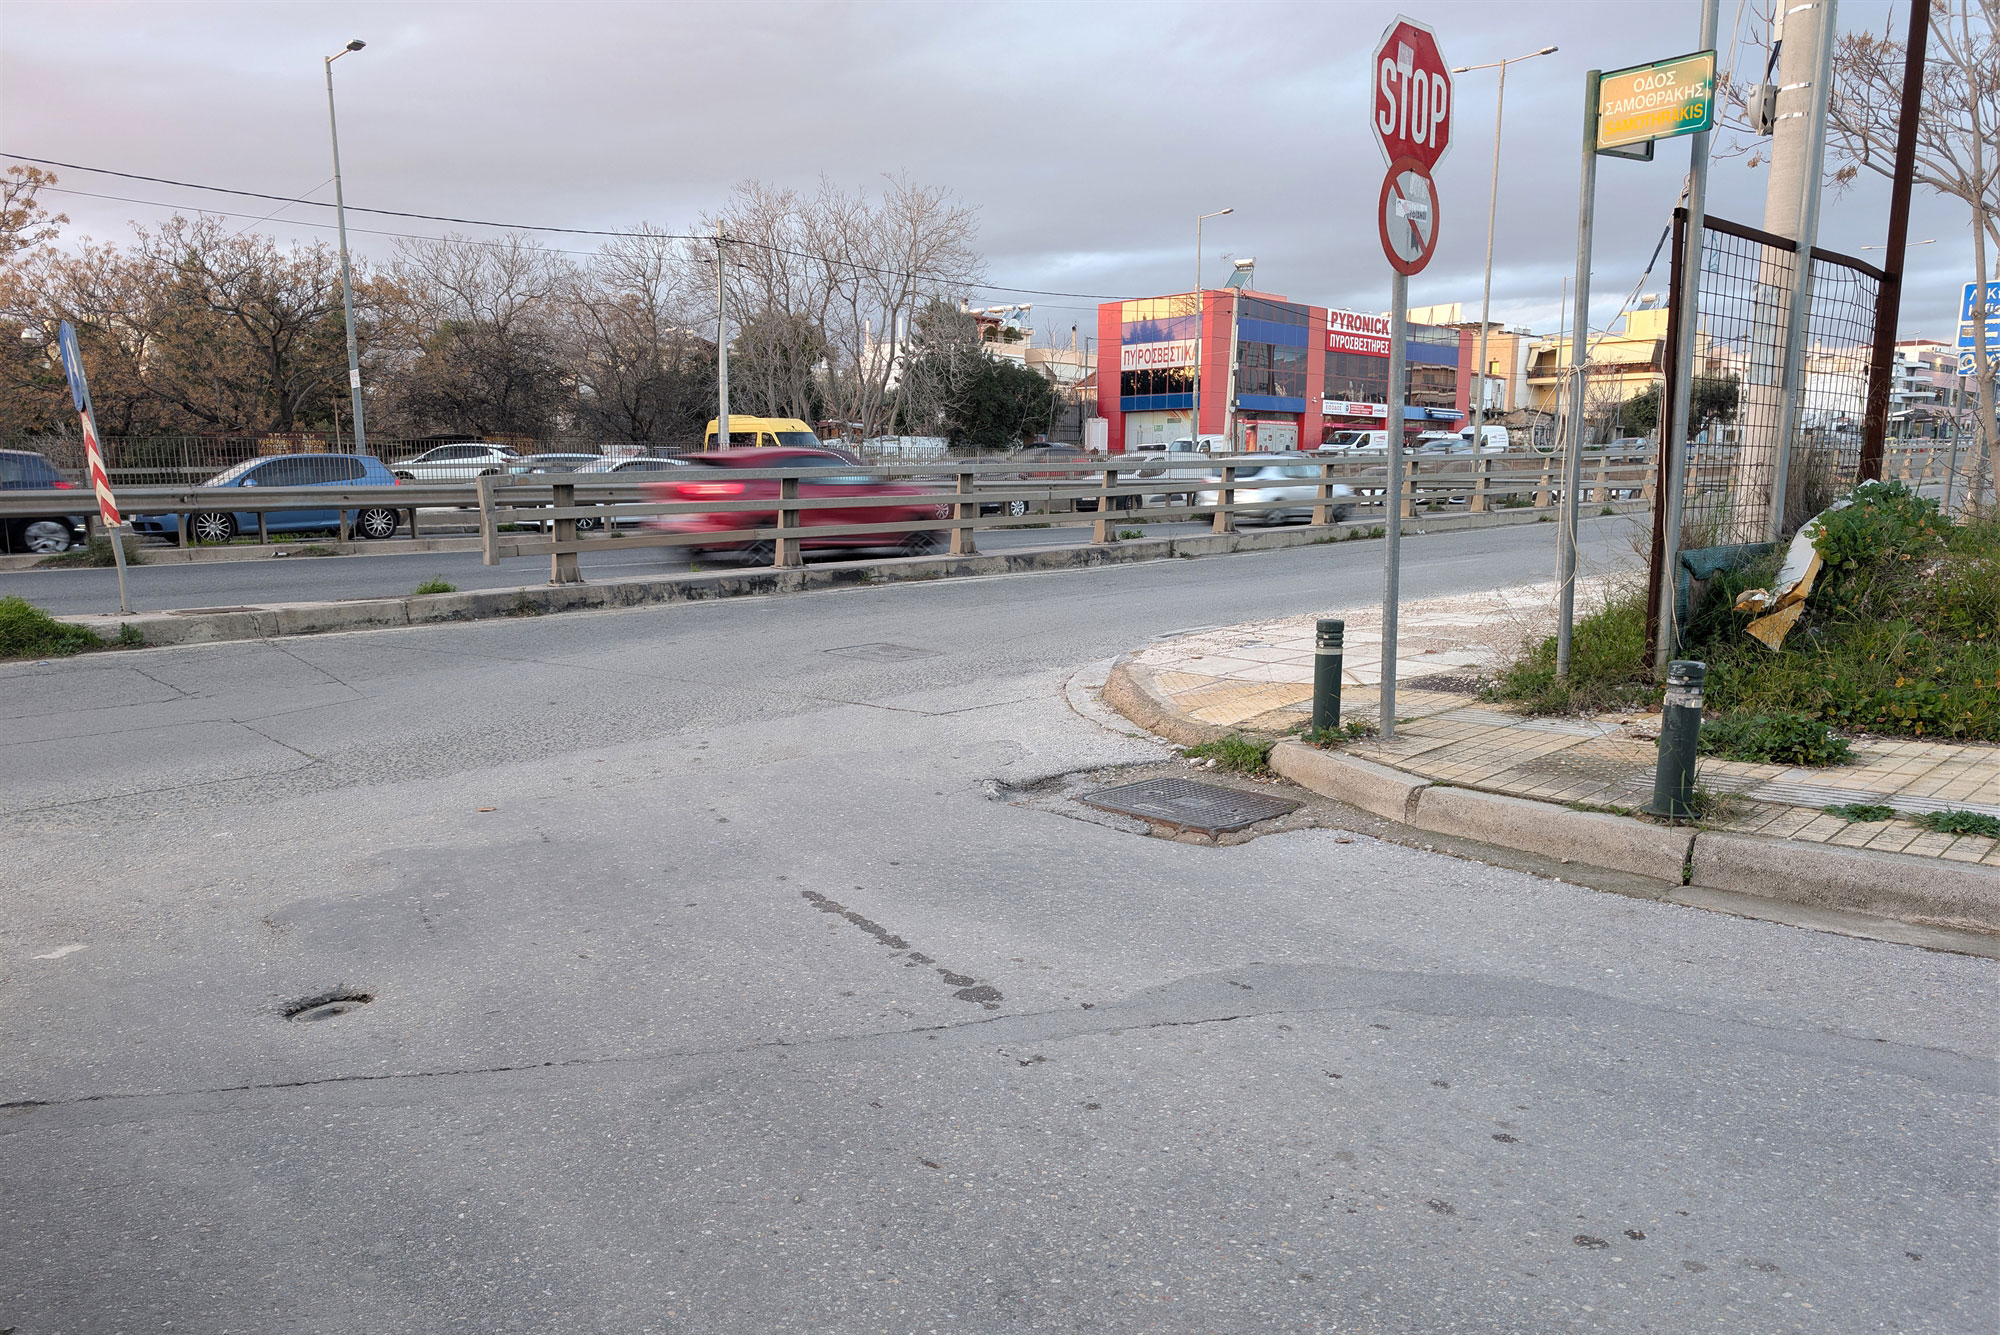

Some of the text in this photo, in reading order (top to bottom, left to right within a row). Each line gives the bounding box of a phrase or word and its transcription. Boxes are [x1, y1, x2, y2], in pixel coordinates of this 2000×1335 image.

[1633, 70, 1677, 93] ΟΔΟΣ
[1379, 57, 1447, 149] STOP
[1605, 82, 1704, 116] ΣΑΜΟΘΡΑΚΗΣ
[1605, 103, 1704, 137] SAMOTHRAKIS
[1331, 311, 1390, 336] PYRONICK
[1329, 334, 1389, 354] ΠΥΡΟΣΒΕΣΤΗΡΕΣ
